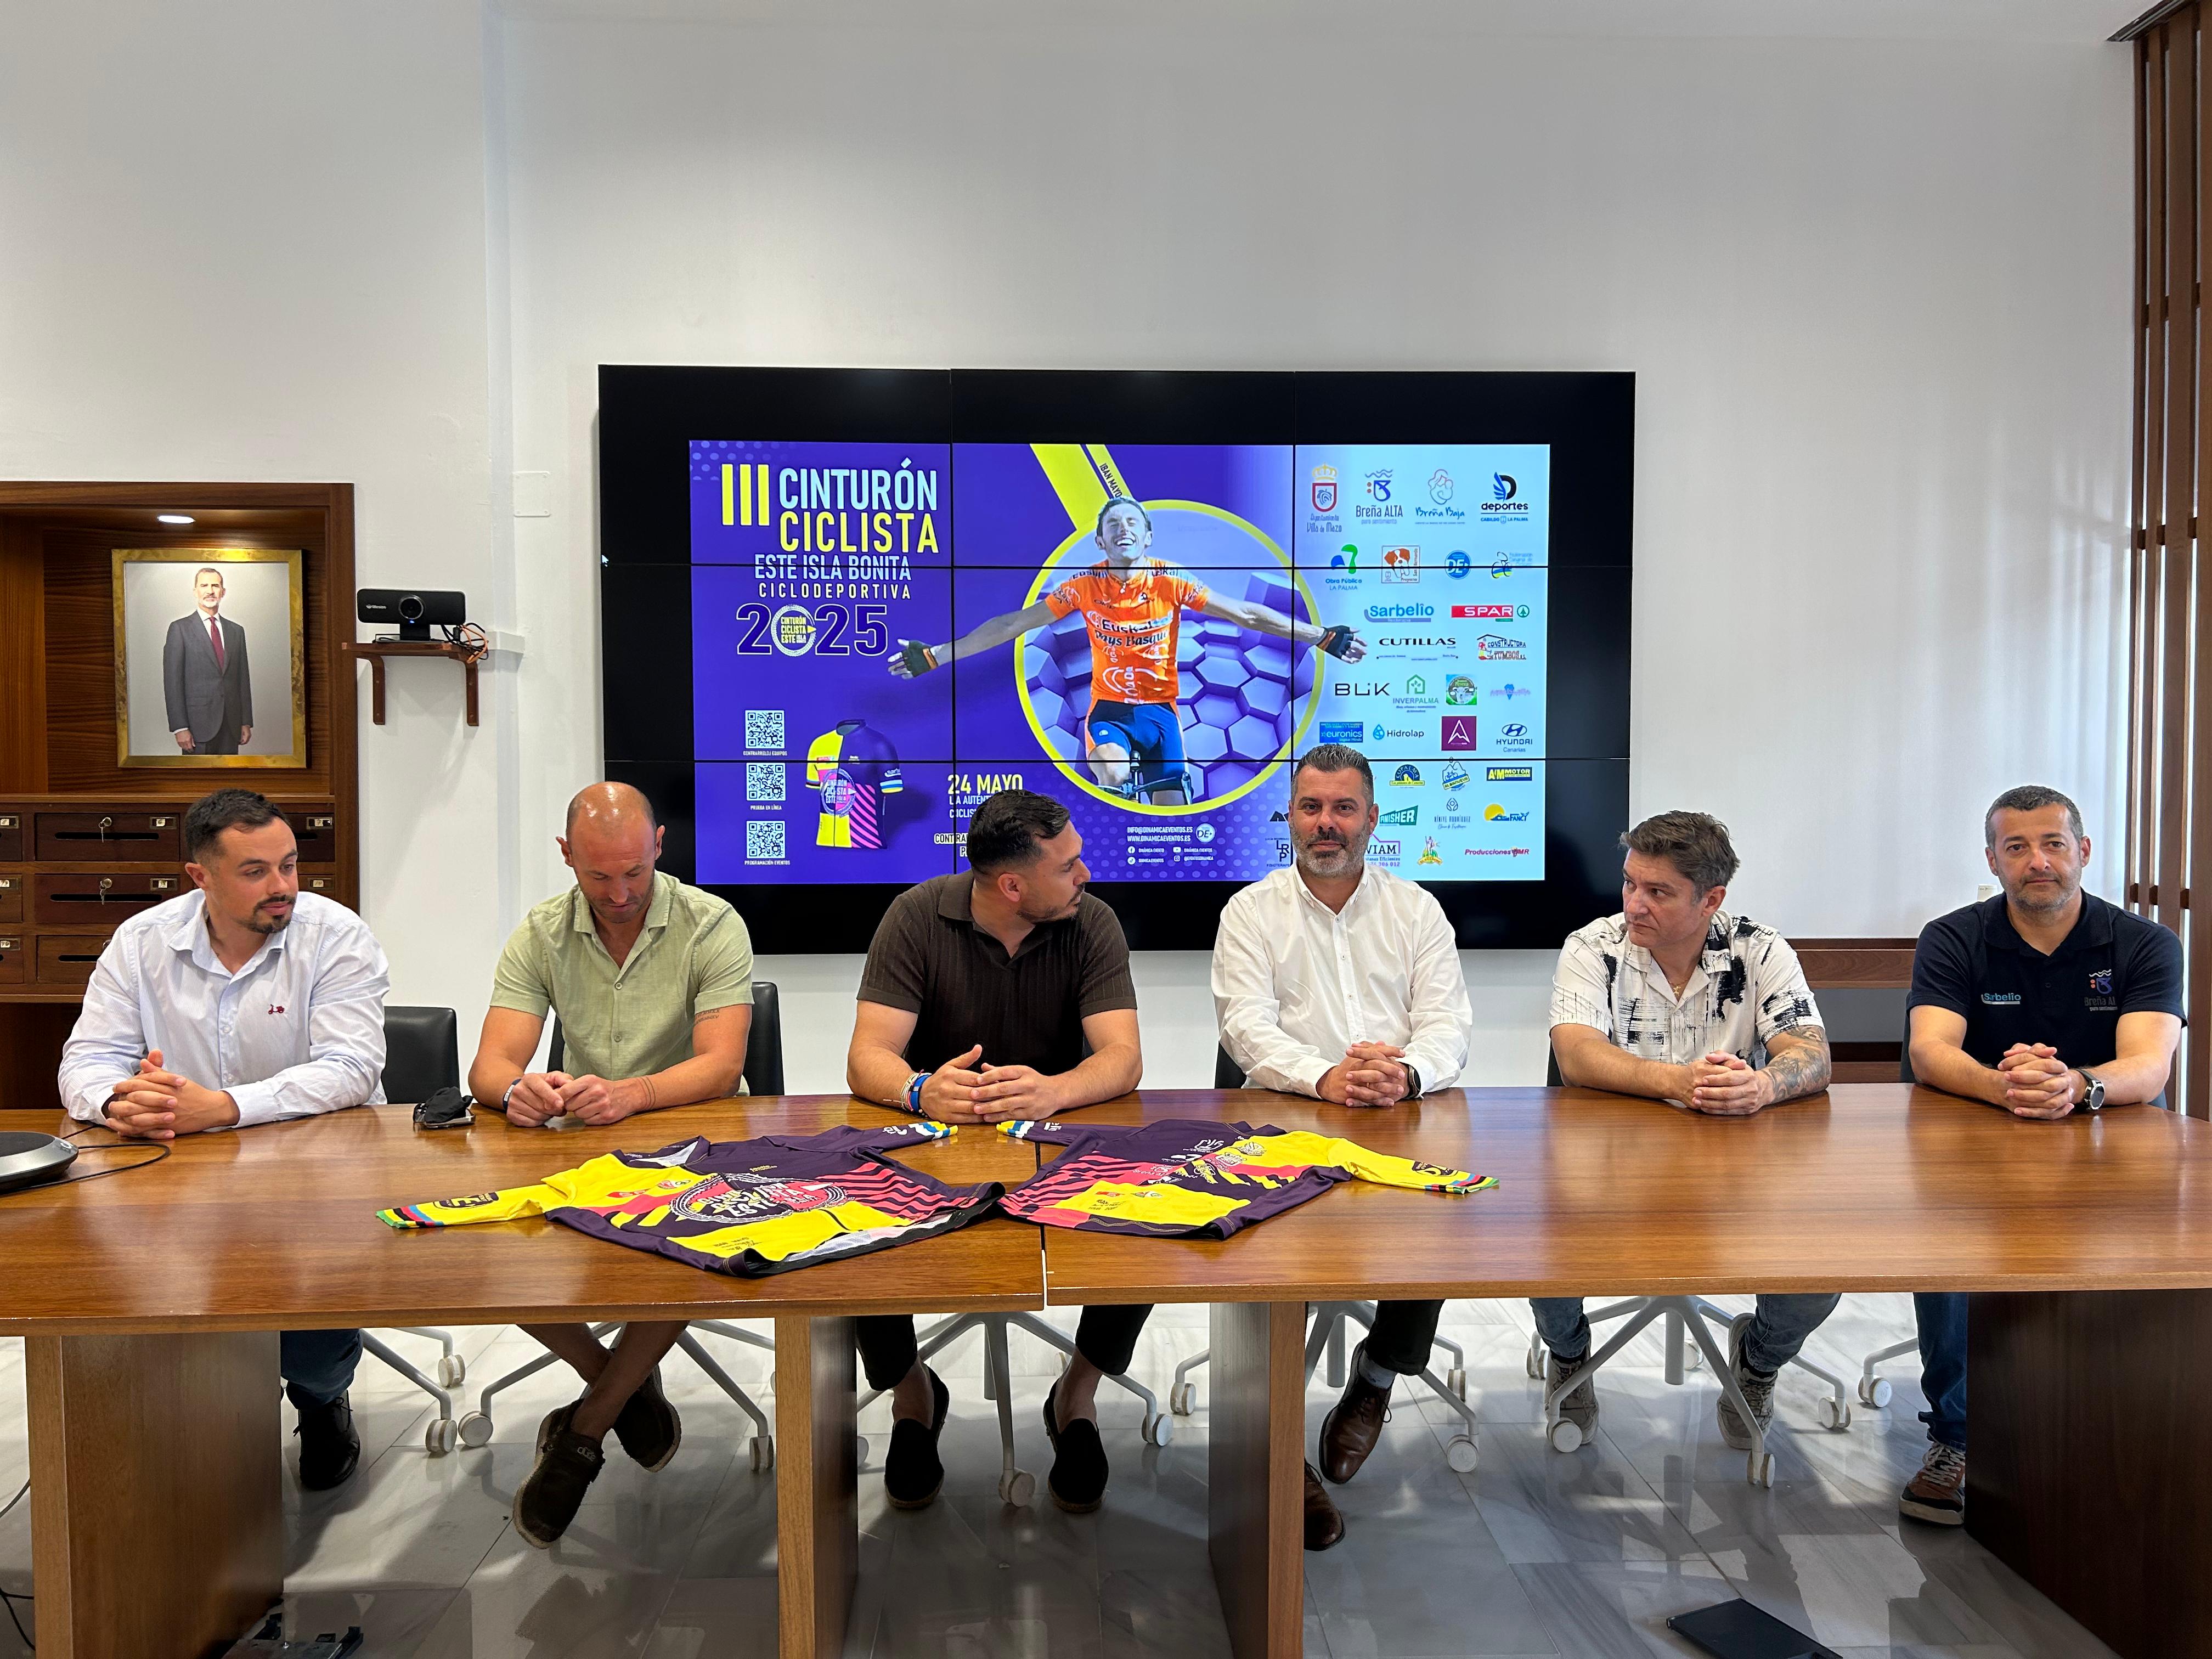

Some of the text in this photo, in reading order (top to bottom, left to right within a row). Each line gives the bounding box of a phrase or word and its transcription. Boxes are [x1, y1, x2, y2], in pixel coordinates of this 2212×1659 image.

[779, 457, 937, 510] CINTURÓN
[1099, 463, 1122, 498] IBAN MAYO
[721, 464, 770, 526] III
[1356, 505, 1403, 517] Breña ALTA
[1481, 503, 1528, 512] deportes
[1415, 506, 1465, 520] Breña Baja
[780, 512, 939, 553] CICLISTA
[1307, 522, 1319, 533] Villa
[1326, 522, 1342, 533] Mazo
[755, 554, 912, 580] ESTE ISLA BONITA
[759, 583, 911, 599] CICLODEPORTIVA
[1464, 606, 1513, 616] SPAR
[781, 615, 806, 625] CINTURÓN
[781, 625, 806, 634] CICLISTA
[781, 634, 795, 643] ESTE
[1379, 637, 1457, 646] CUTILLAS
[1487, 639, 1526, 647] CONSTRUCTORA
[1326, 729, 1362, 738] euronics
[1387, 729, 1424, 738] Hidrolap
[1395, 765, 1419, 778] COPALMA
[947, 774, 1023, 794] 24 MAYO
[949, 795, 961, 805] LA
[935, 834, 968, 843] CONTRA
[2084, 996, 2106, 1006] Breña
